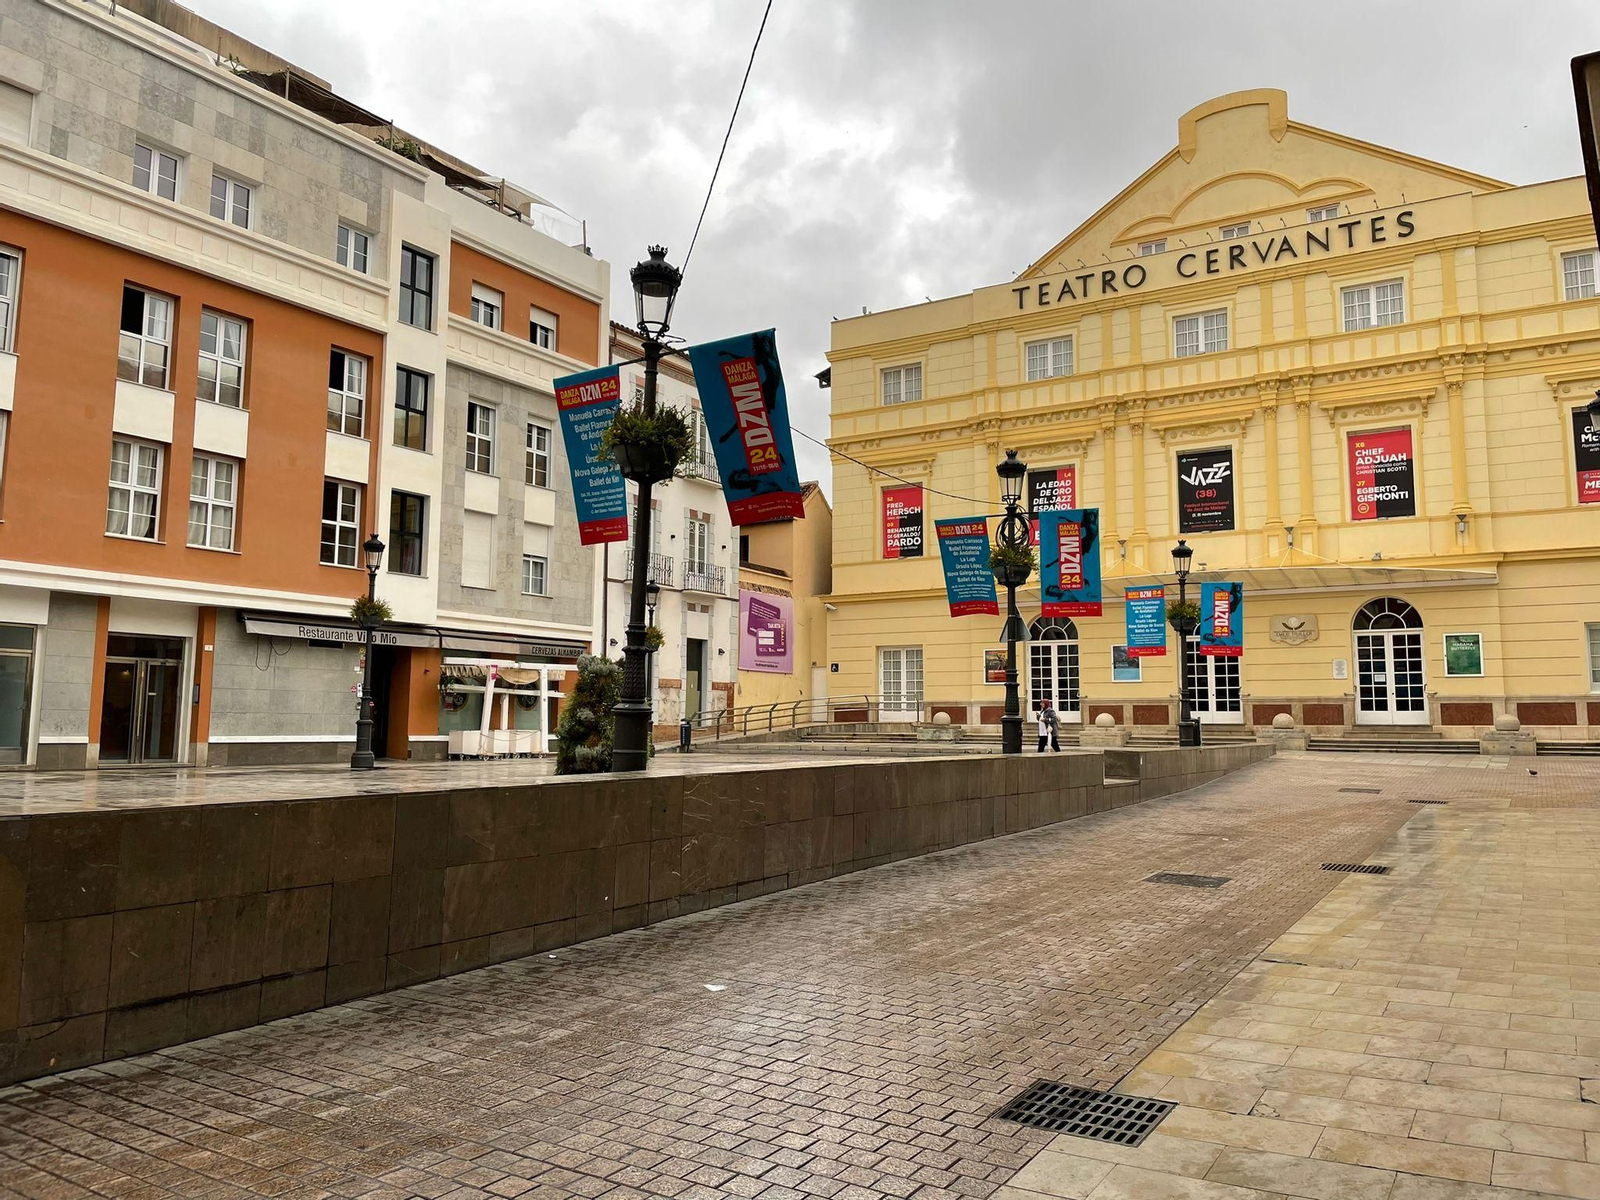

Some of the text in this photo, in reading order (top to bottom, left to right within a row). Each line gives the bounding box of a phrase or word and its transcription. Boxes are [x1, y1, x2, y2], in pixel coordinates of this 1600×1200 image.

[1012, 210, 1414, 310] TEATRO CERVANTES
[724, 361, 754, 376] DANZA
[728, 371, 757, 384] MÁLAGA
[560, 388, 580, 400] DANZA
[580, 380, 616, 402] DZM 24
[562, 396, 581, 406] MÁLAGA
[569, 411, 592, 422] Manuela
[732, 381, 774, 447] DZM
[574, 422, 591, 433] Ballet
[750, 446, 778, 464] 24
[1356, 448, 1384, 456] CHIEF
[1356, 453, 1406, 466] ADJUAH
[574, 468, 590, 477] Nova
[590, 466, 608, 475] Galega
[1180, 462, 1230, 486] JAZZ
[589, 478, 605, 487] Ballet
[1036, 480, 1072, 490] LA EDAD
[1054, 487, 1072, 495] ORO
[1196, 489, 1217, 499] (38)
[1357, 485, 1398, 494] EGBERTO
[1033, 495, 1072, 506] DEL JAZZ
[1357, 491, 1408, 502] GISMONTI
[887, 506, 920, 516] HERSCH
[1033, 502, 1072, 512] ESPAÑOL
[955, 525, 971, 535] DZM
[888, 537, 921, 547] PARDO
[1060, 536, 1080, 574] DZM
[1062, 574, 1080, 584] 24
[1140, 590, 1151, 598] DZM
[1215, 600, 1228, 626] DZM
[298, 626, 354, 640] Restaurante
[357, 631, 377, 643] Vio
[532, 646, 584, 657] CERVEZAS ALHAMBR
